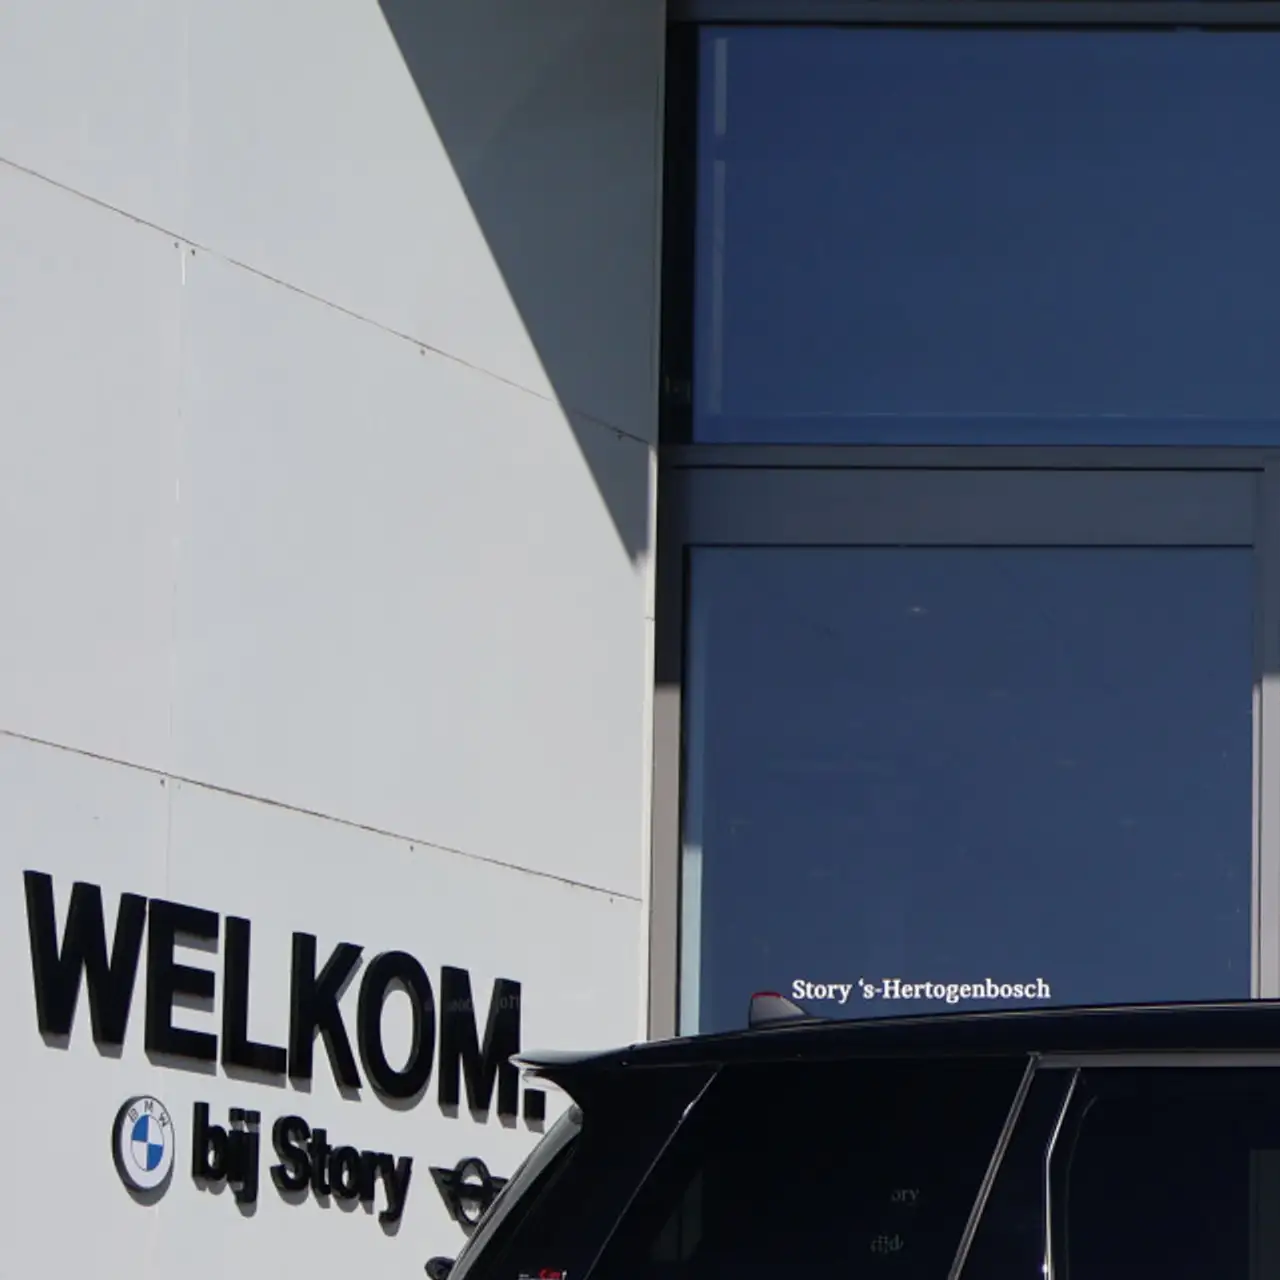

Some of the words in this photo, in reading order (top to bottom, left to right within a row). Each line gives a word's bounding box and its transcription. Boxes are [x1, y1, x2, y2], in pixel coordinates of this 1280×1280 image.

[23, 869, 546, 1120] WELKOM.
[791, 979, 852, 1004] Story
[127, 1100, 169, 1128] BMW
[270, 1116, 414, 1222] Story
